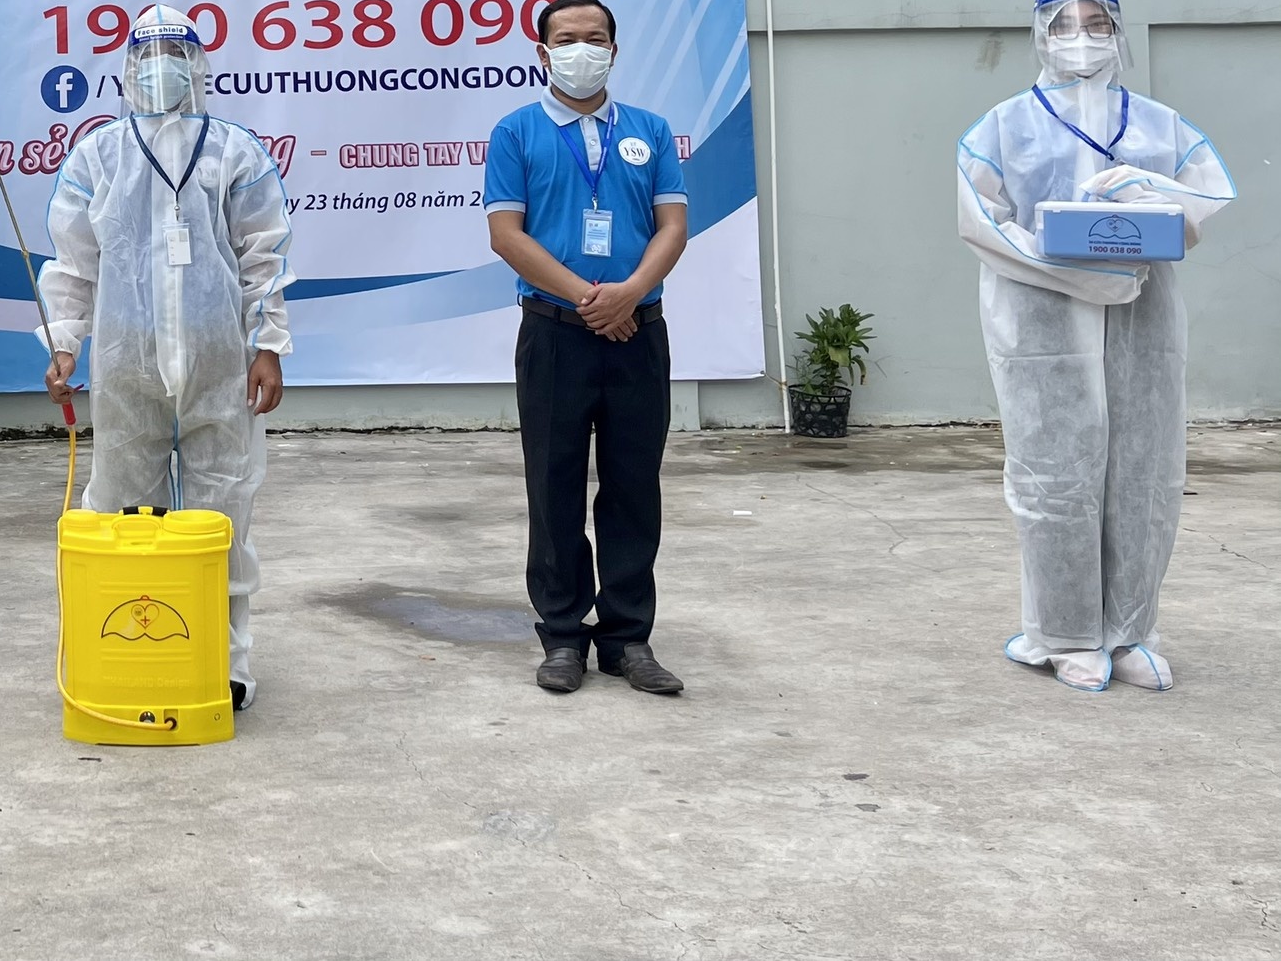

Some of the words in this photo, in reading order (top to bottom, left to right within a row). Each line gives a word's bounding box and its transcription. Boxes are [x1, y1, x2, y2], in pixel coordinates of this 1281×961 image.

[44, 3, 228, 55] 190
[339, 142, 420, 169] CHUNG
[423, 141, 464, 167] TAY
[624, 147, 645, 158] YSW
[304, 194, 327, 210] 23
[333, 192, 389, 213] tháng
[394, 192, 416, 208] 08
[421, 191, 464, 208] năm
